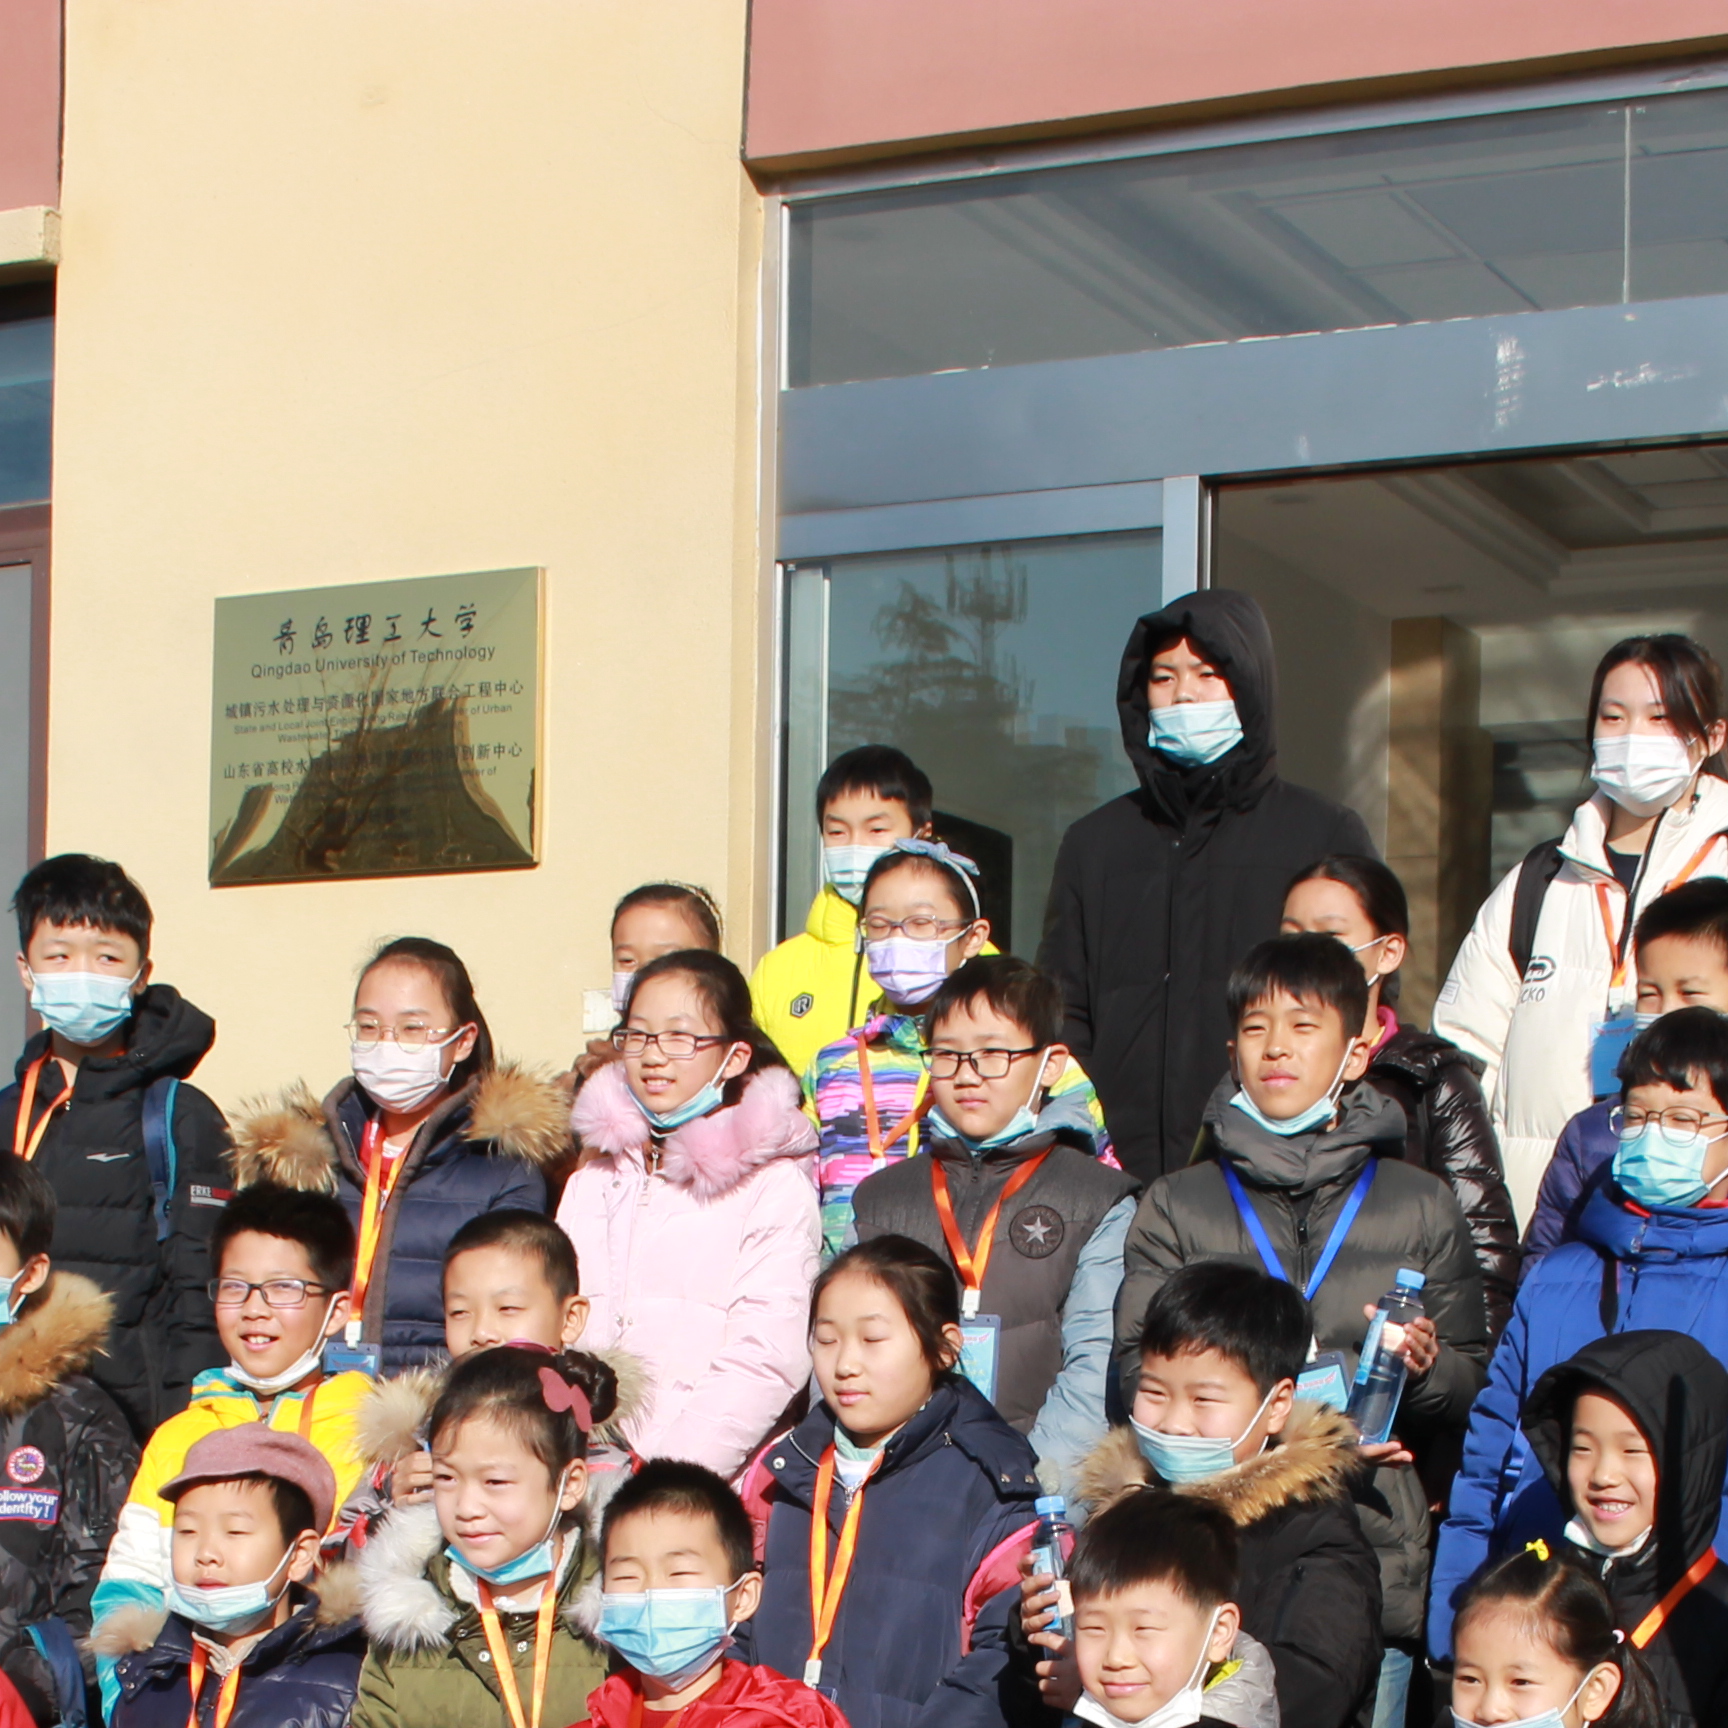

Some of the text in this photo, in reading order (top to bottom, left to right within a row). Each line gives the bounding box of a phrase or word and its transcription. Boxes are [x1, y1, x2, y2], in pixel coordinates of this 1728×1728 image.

[273, 603, 477, 656] 青岛理工大学
[251, 646, 496, 680] Qingdao University of Technology
[29, 1492, 59, 1506] your
